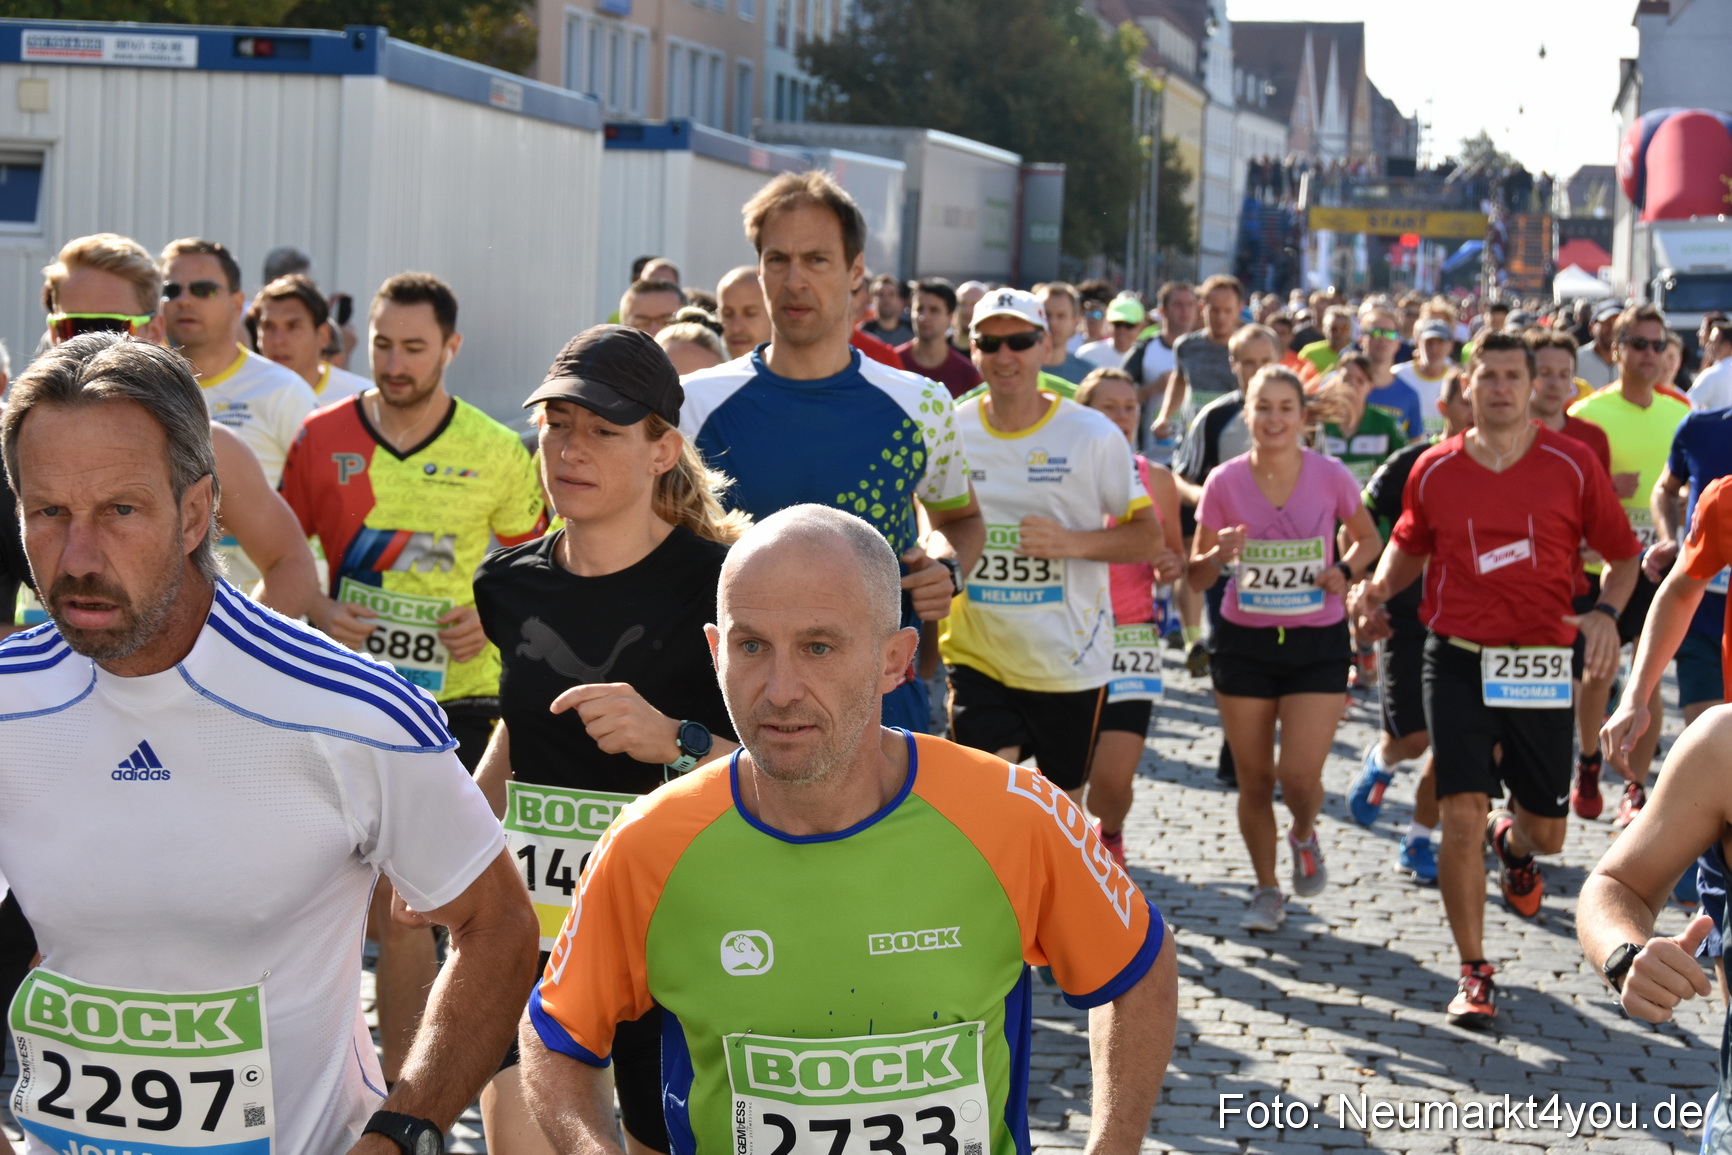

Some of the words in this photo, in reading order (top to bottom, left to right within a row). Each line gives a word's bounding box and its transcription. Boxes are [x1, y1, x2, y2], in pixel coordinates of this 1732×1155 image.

[1369, 214, 1427, 229] START
[1028, 452, 1049, 465] 20
[1244, 543, 1317, 560] BOCK
[976, 555, 1050, 582] 2353
[1246, 565, 1315, 589] 2424
[982, 589, 1045, 602] HELMUT
[366, 625, 436, 663] 688
[1112, 651, 1155, 673] 422
[1495, 655, 1562, 678] 2559
[1500, 685, 1558, 698] THOMAS
[111, 767, 171, 781] adidas
[517, 793, 616, 834] BOC
[1007, 763, 1135, 930] BOCK
[517, 843, 590, 896] 14
[868, 926, 962, 955] BOCK
[27, 982, 240, 1048] BOCK
[246, 1070, 258, 1083] C
[748, 1037, 960, 1095] BOCK
[38, 1050, 235, 1132] 2297
[763, 1105, 959, 1155] 2733
